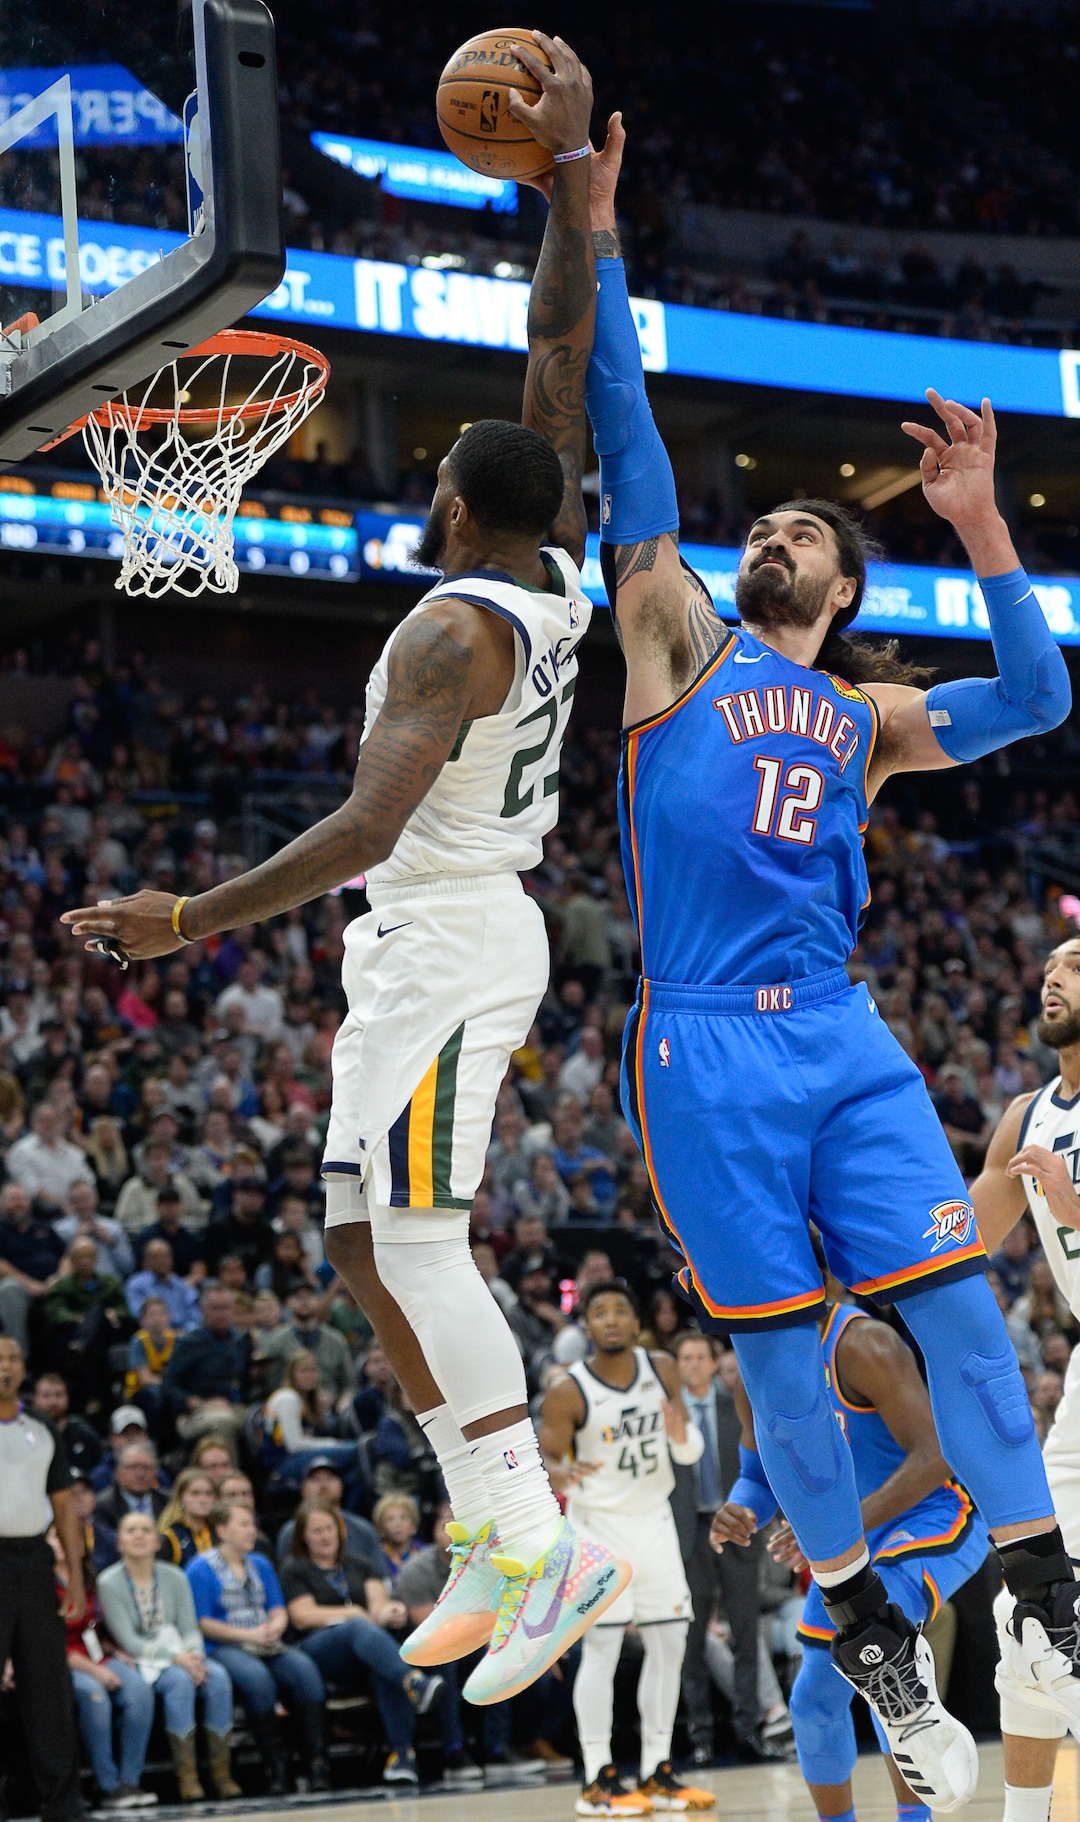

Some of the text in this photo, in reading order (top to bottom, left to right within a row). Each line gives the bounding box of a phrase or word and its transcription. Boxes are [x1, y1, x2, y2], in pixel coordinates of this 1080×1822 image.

[354, 258, 407, 333] IT
[712, 685, 861, 778] THUNDER
[752, 754, 825, 846] 12
[756, 986, 793, 1012] OKC
[939, 1207, 966, 1239] OKC
[617, 1438, 658, 1478] 45
